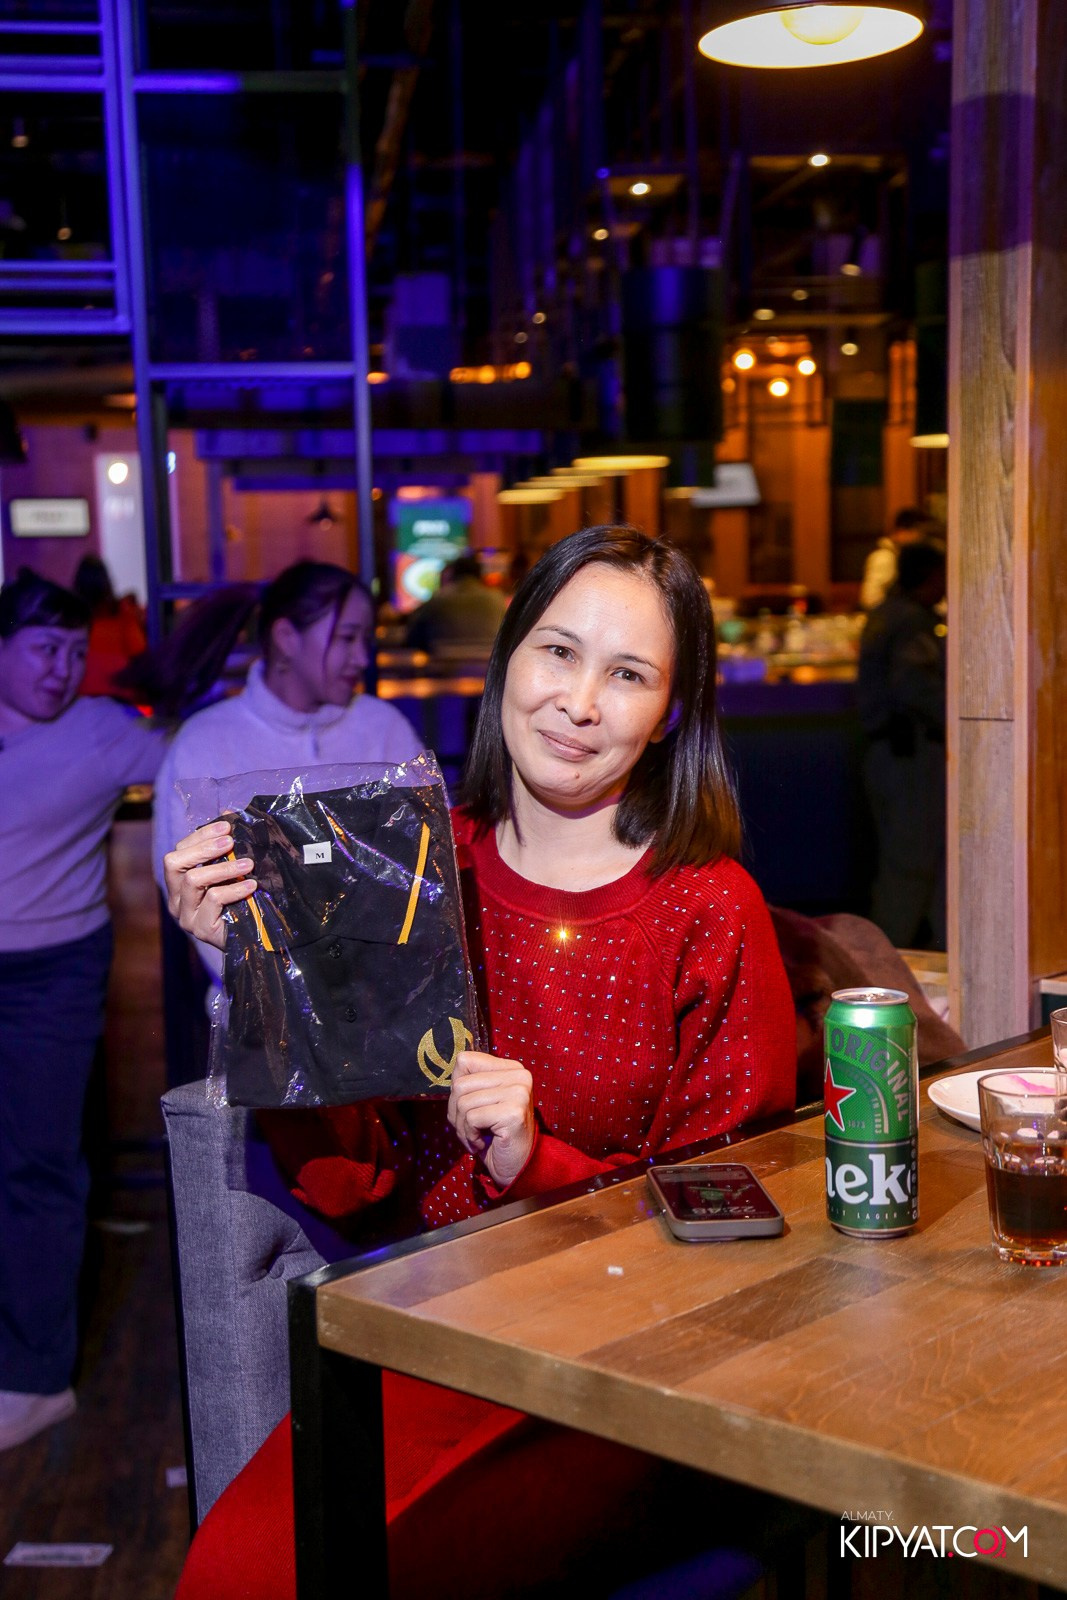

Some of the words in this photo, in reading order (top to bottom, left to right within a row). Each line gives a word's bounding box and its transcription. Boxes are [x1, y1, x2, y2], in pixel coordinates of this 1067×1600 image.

[831, 1027, 909, 1122] ORIGINAL
[825, 1153, 912, 1206] ek
[856, 1211, 898, 1220] LAGER
